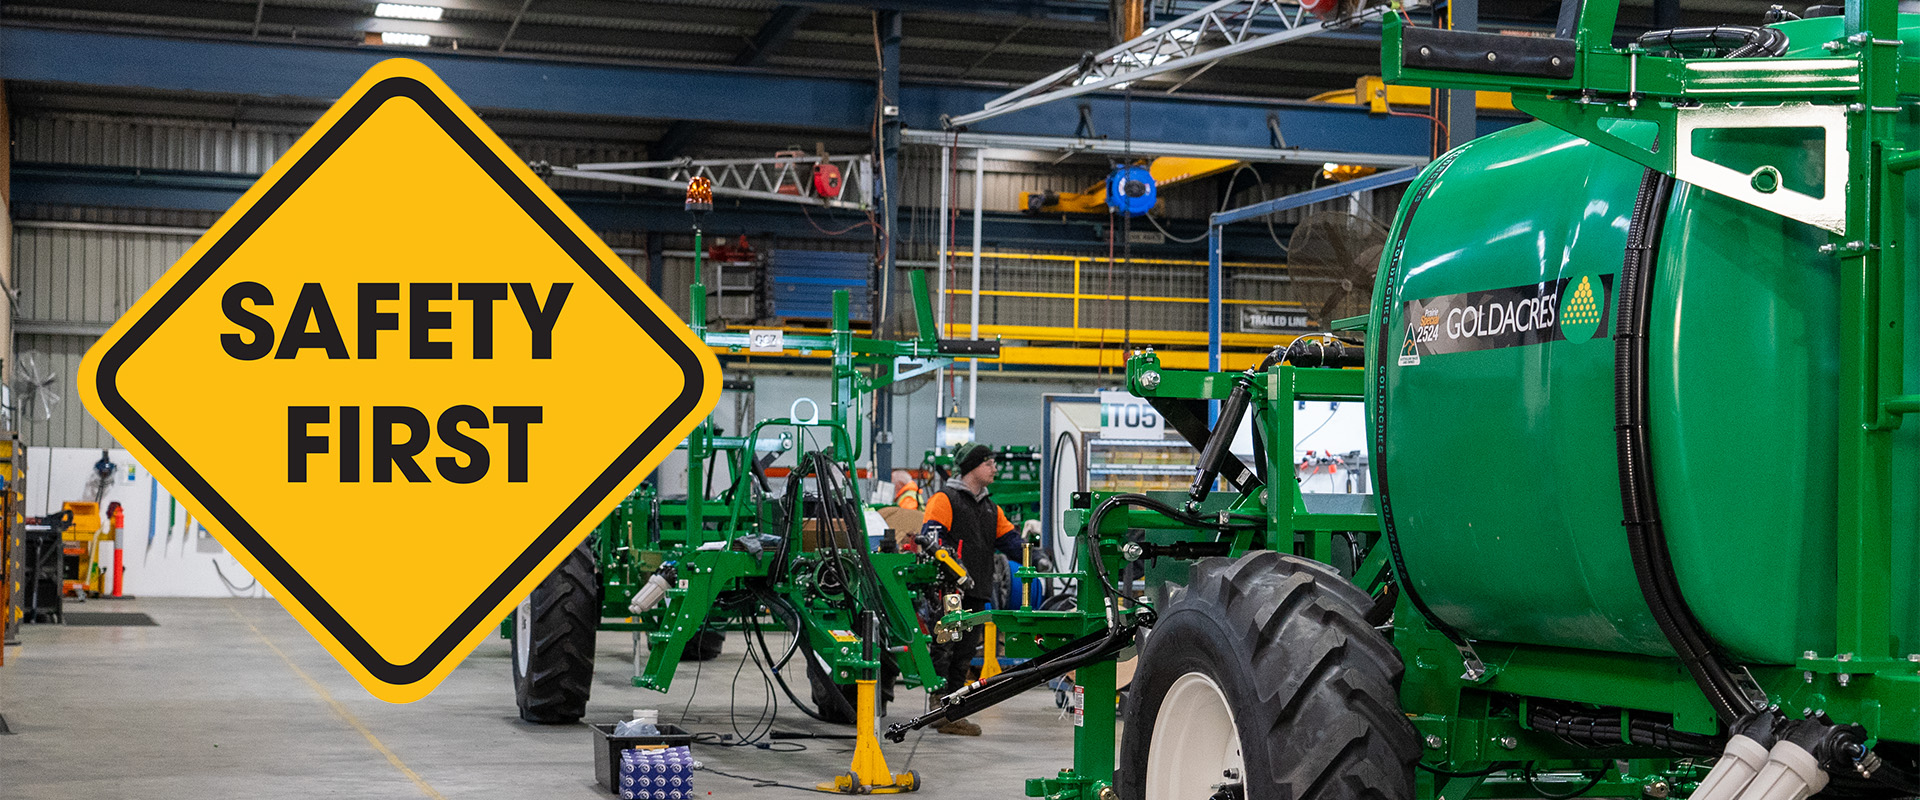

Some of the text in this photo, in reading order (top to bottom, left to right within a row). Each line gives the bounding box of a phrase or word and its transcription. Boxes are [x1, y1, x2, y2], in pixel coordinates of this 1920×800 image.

[1250, 314, 1308, 328] TRAILED LINE
[1447, 293, 1557, 340] GOLDACRES
[1416, 324, 1440, 343] 2524
[1378, 365, 1386, 454] GOLDACRES
